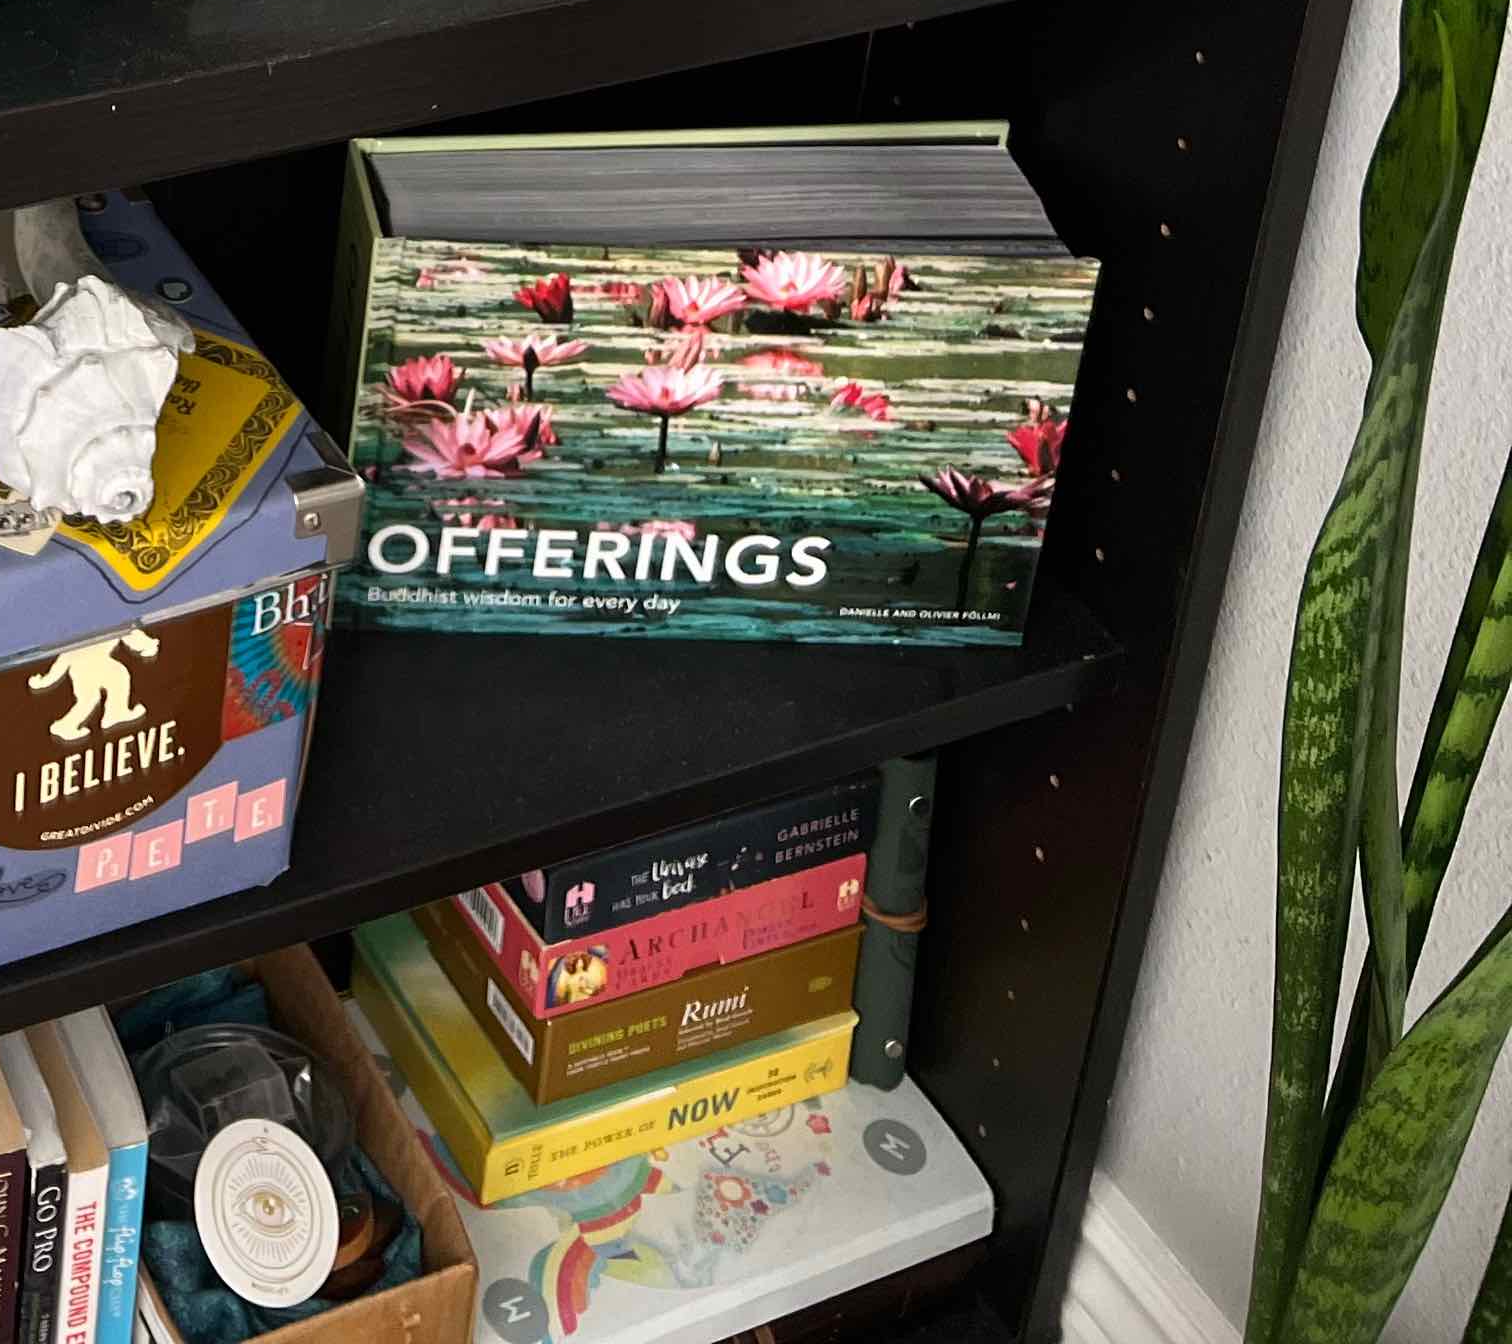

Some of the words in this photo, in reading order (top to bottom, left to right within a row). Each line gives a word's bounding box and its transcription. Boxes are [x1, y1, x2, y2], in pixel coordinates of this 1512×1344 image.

[368, 525, 832, 587] OFFERINGS
[367, 587, 457, 605] Buddhist
[463, 590, 541, 608] wisdom
[548, 590, 579, 609] for
[582, 594, 639, 615] every
[643, 593, 681, 615] day
[14, 771, 26, 813] I
[40, 719, 186, 805] BELIEVE.
[39, 794, 155, 842] GREATDIVIDE.COM
[777, 808, 860, 843] GABRIELLE
[774, 828, 860, 864] BERNSTEIN
[680, 986, 750, 1027] Rumi
[550, 1144, 578, 1163] THE
[583, 1127, 635, 1152] POWER
[666, 1087, 741, 1132] NOW
[37, 1185, 62, 1224] GO
[75, 1200, 98, 1237] THE
[31, 1226, 59, 1273] PRO
[66, 1237, 95, 1330] COMPOUND
